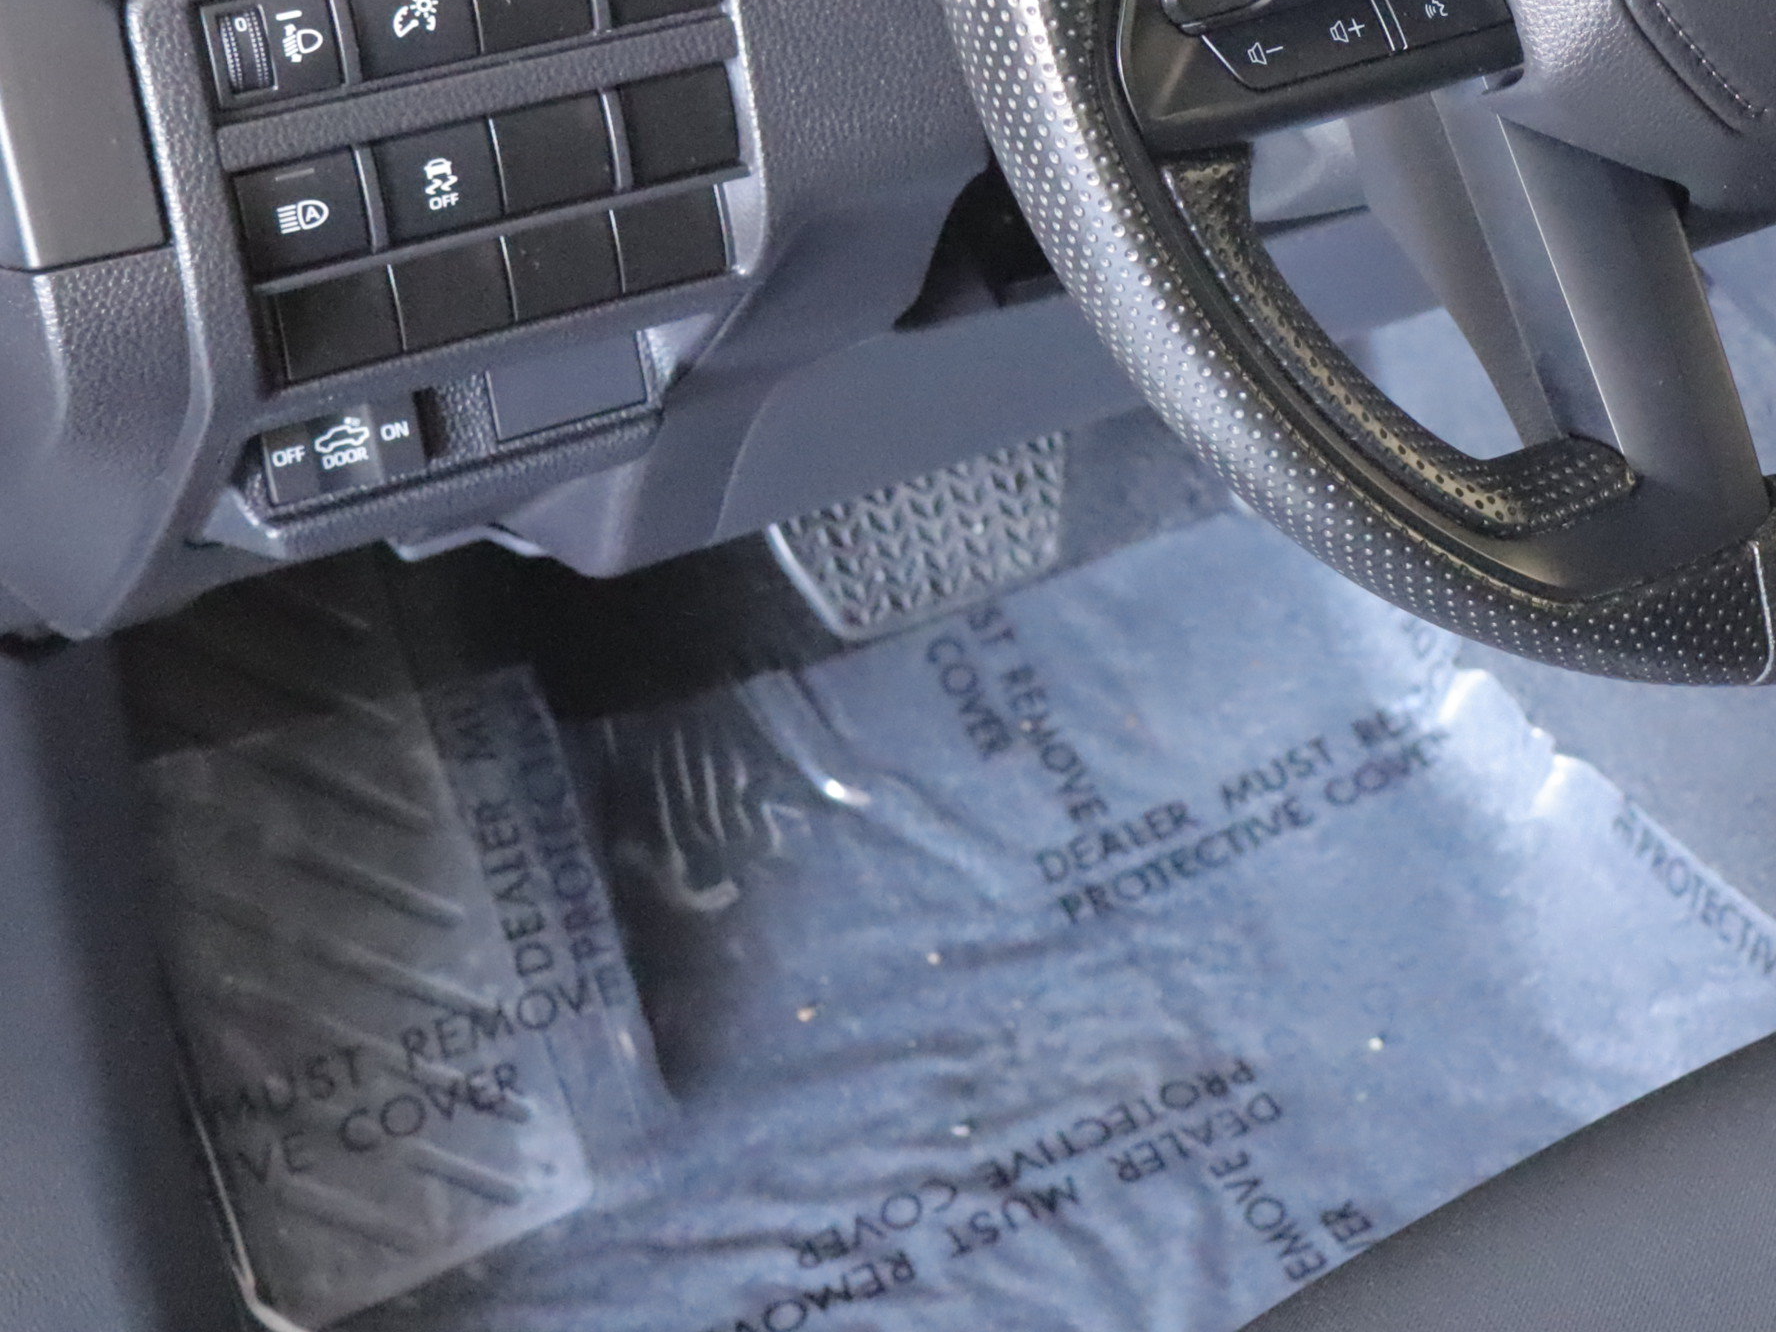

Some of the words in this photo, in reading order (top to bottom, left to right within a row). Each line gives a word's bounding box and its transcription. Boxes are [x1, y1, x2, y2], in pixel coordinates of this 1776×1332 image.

[428, 191, 460, 211] OFF
[271, 444, 306, 468] OFF
[321, 446, 370, 470] DOOR
[380, 420, 410, 442] ON
[1001, 661, 1108, 822] REMOVE
[1035, 800, 1197, 884] DEALER
[1220, 736, 1333, 811] MUST
[1059, 794, 1316, 926] PROTECTIVE
[473, 798, 554, 978] DEALER
[401, 966, 624, 1070] REMOVE
[337, 1063, 519, 1153] COVER
[985, 1058, 1256, 1192] PROTECTIVE
[1107, 1091, 1282, 1183] DEALER
[795, 1177, 958, 1268] COVER
[946, 1175, 1080, 1258] MUST
[1208, 1150, 1327, 1282] EMOVE
